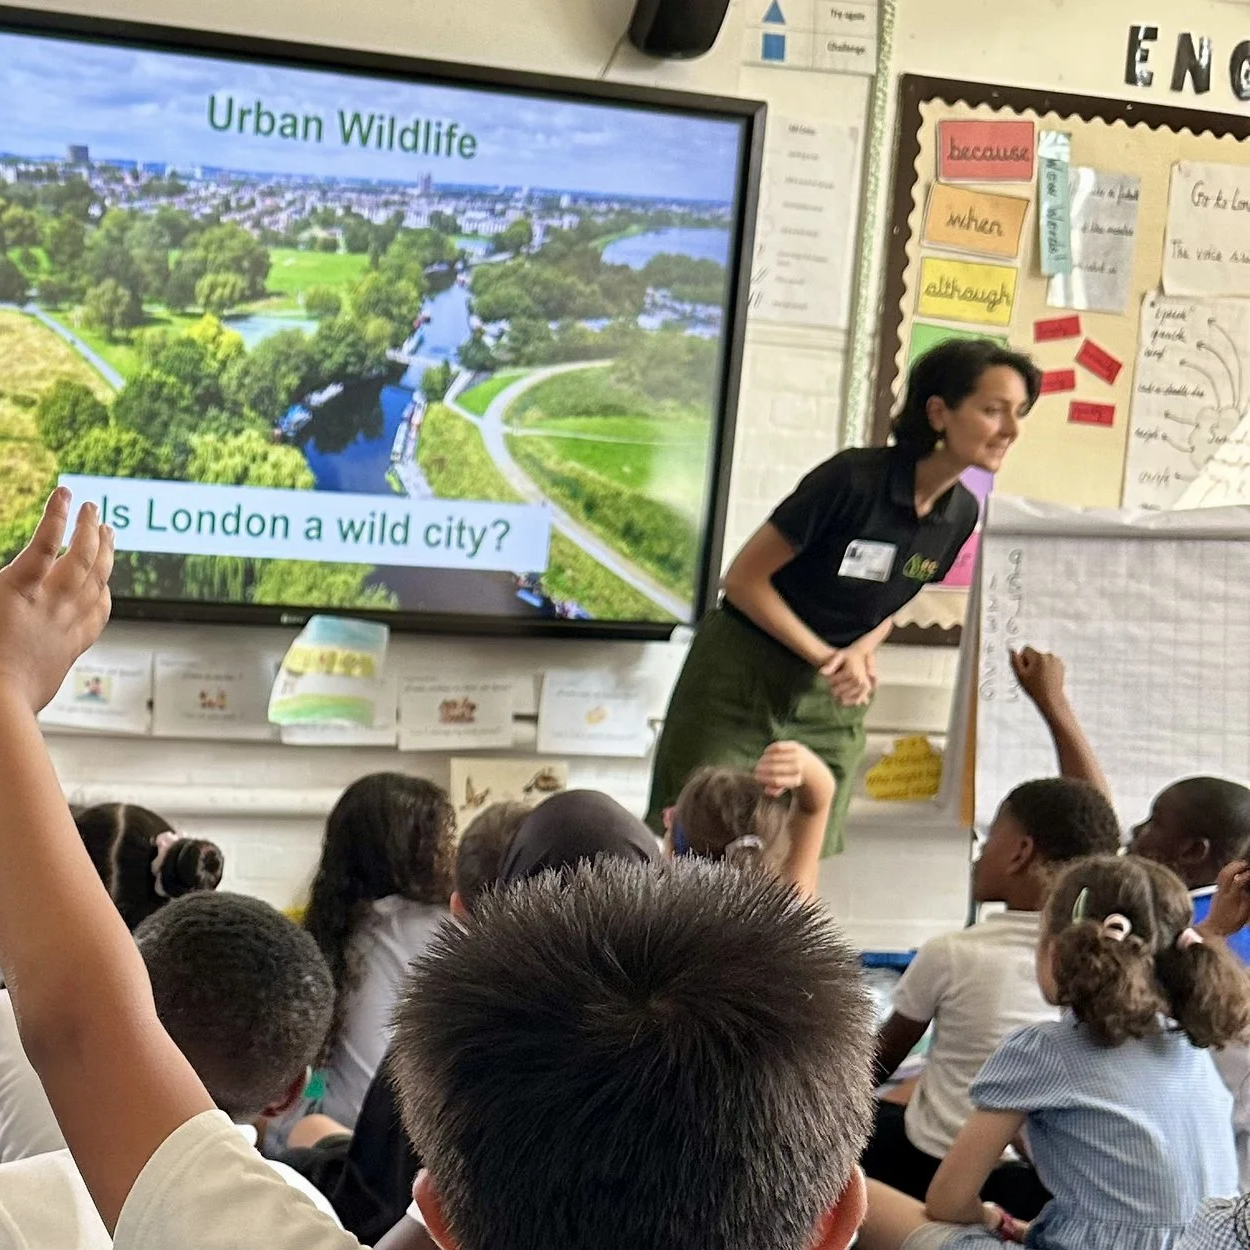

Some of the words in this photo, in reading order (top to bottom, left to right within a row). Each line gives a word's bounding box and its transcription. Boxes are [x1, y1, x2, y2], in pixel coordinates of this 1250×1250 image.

[207, 94, 323, 143] Urban
[338, 109, 477, 159] Wildlife
[947, 137, 1030, 162] because
[945, 206, 1003, 237] when
[924, 275, 1012, 312] although
[101, 496, 130, 530] Is
[146, 498, 289, 539] London
[304, 517, 323, 541] a
[337, 511, 410, 546] wild
[423, 516, 511, 558] city?
